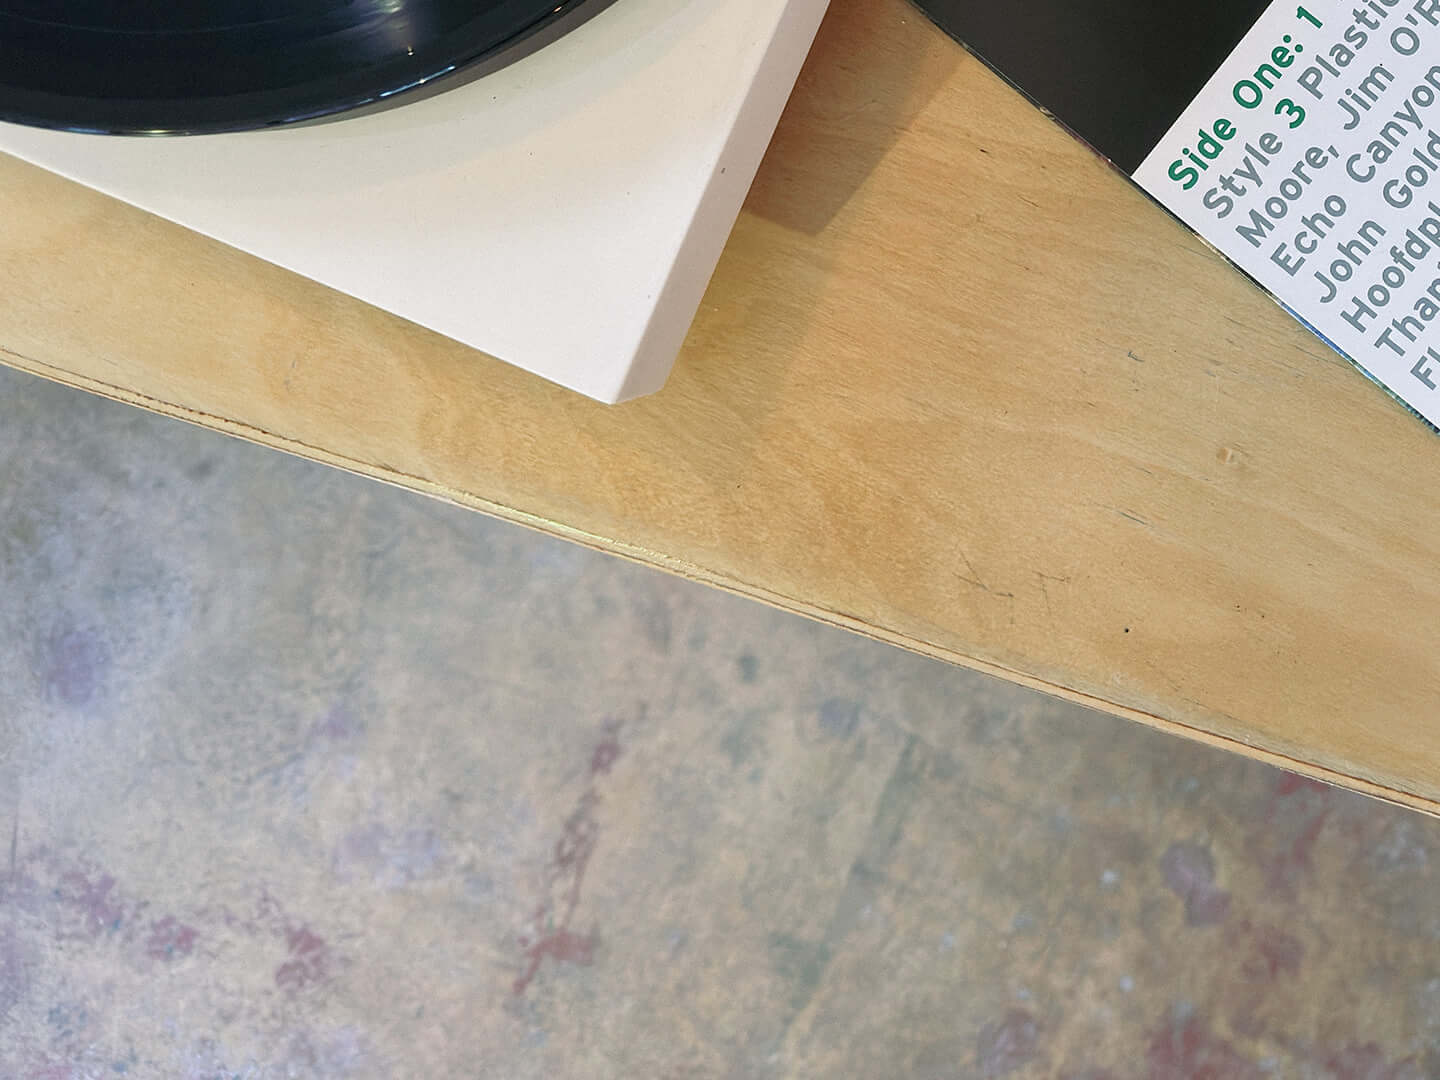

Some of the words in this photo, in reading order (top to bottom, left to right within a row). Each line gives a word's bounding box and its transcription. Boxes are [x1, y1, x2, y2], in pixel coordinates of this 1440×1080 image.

[1167, 117, 1237, 191] Side
[1231, 33, 1303, 109] One:
[1295, 4, 1323, 29] 1
[1202, 131, 1283, 219] Style
[1273, 97, 1306, 129] 3
[1234, 144, 1339, 248] Moore,
[1336, 62, 1395, 130] Jim
[1269, 194, 1347, 277] Echo
[1312, 219, 1387, 304] John
